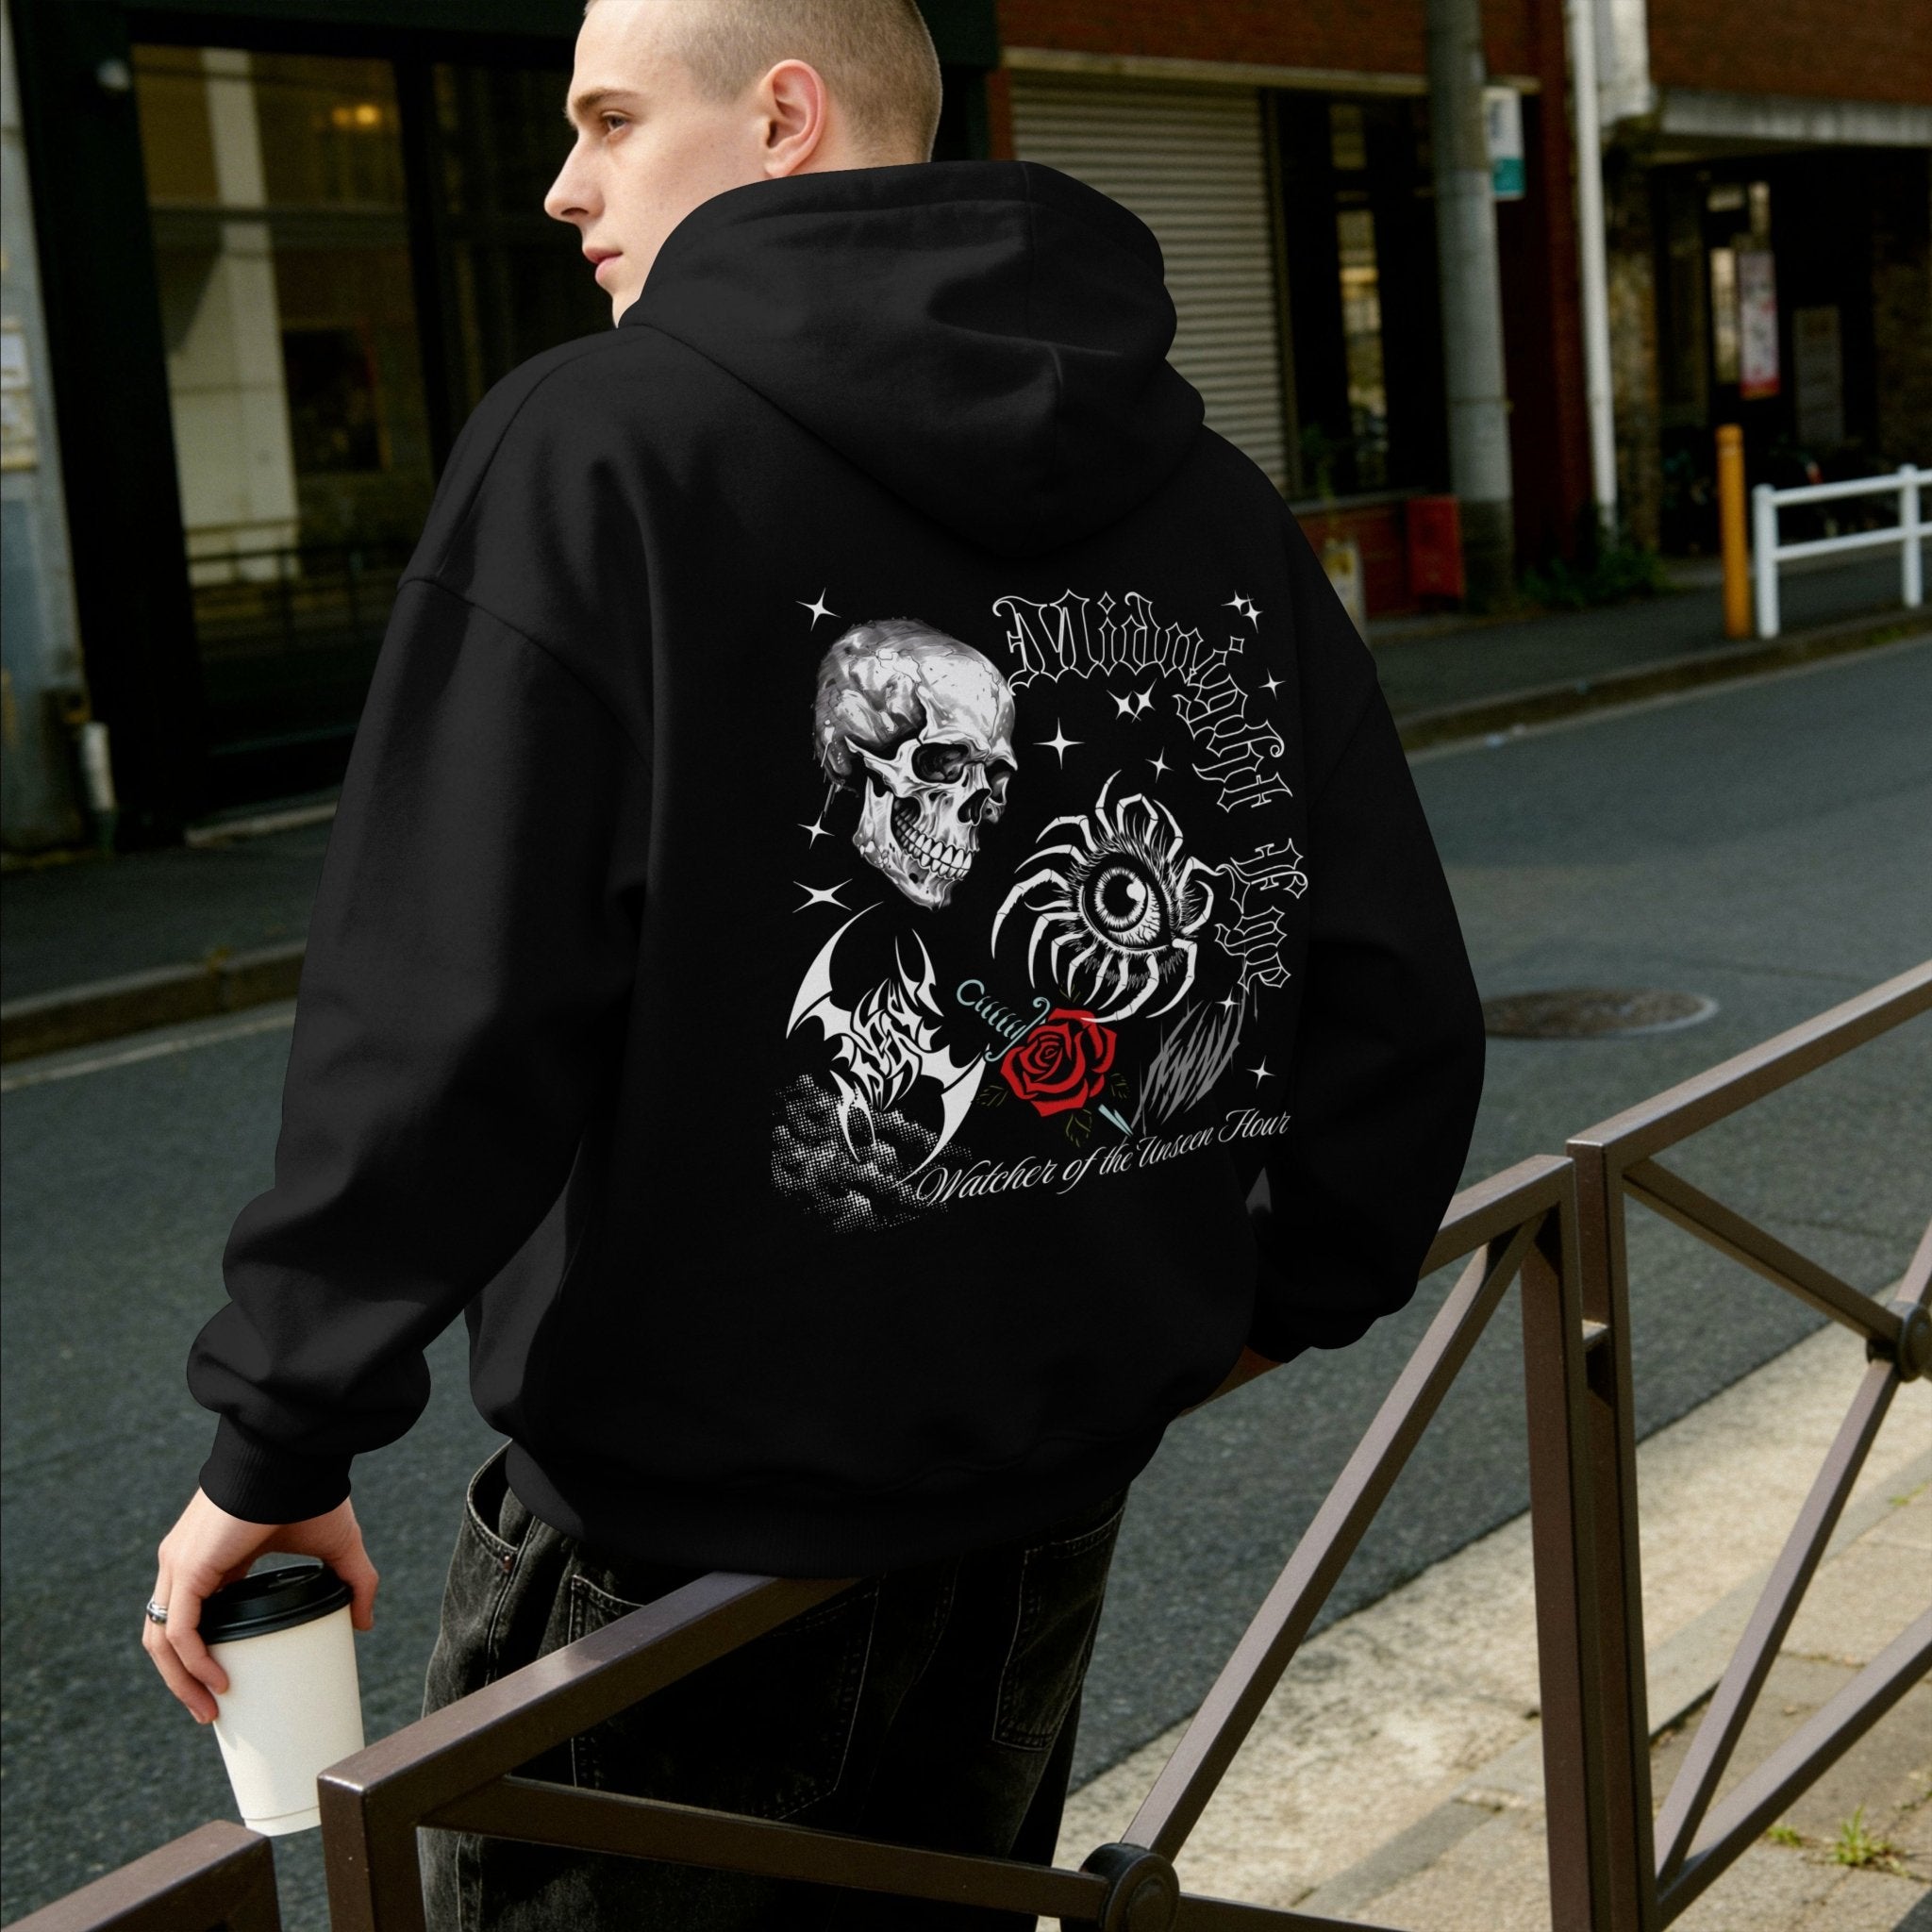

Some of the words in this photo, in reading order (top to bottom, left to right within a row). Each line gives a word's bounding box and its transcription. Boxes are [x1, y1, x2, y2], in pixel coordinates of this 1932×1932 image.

[992, 589, 1292, 812] Midnight
[1215, 838, 1308, 992] Eye
[917, 1156, 1058, 1207] Watcher
[1057, 1146, 1107, 1195] of
[1099, 1141, 1134, 1175] the
[1137, 1126, 1215, 1168] Unseen
[1218, 1108, 1291, 1143] Hour
